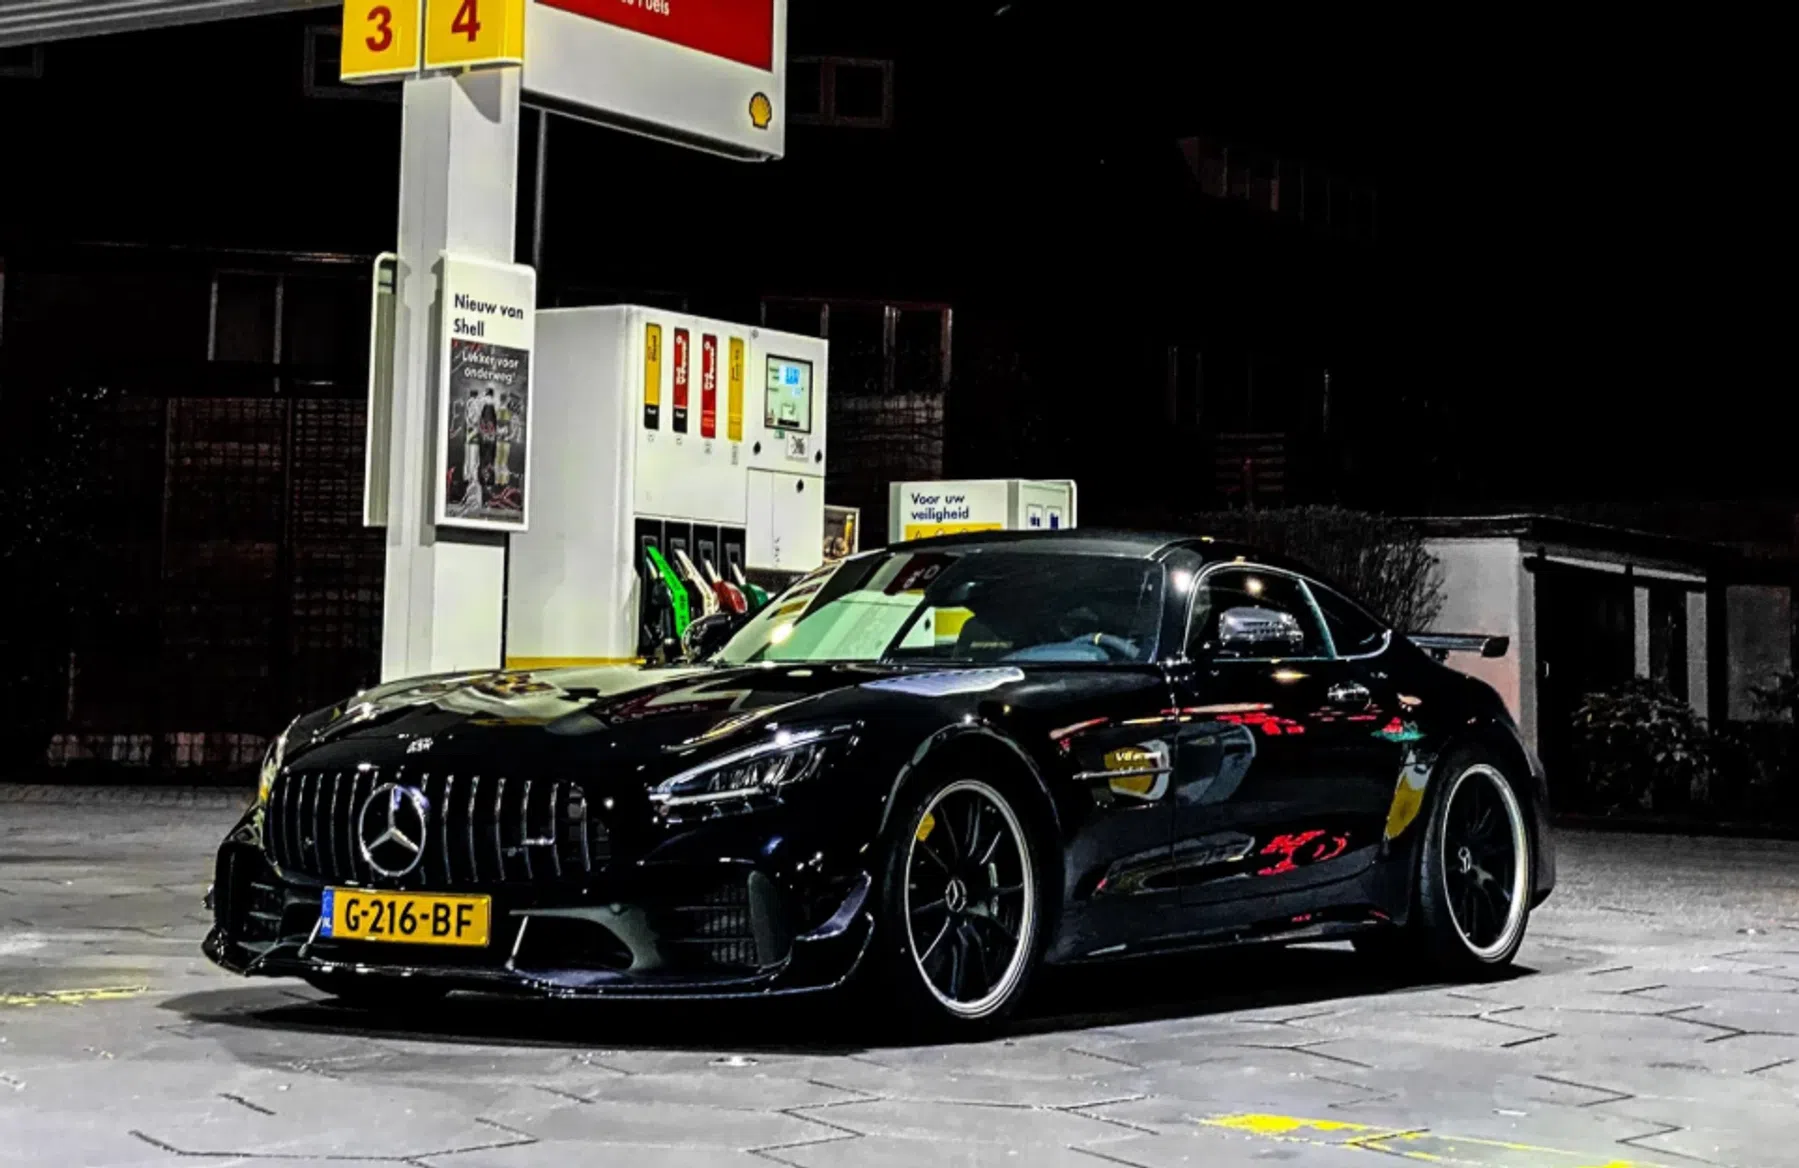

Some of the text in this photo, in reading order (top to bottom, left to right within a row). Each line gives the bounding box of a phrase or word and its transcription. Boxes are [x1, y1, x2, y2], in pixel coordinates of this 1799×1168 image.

[365, 6, 393, 52] 3
[450, 0, 482, 42] 4
[454, 293, 524, 320] Nieuw van
[453, 317, 484, 337] Shell
[911, 492, 965, 505] Voor uw
[911, 507, 969, 522] veiligheid
[345, 898, 474, 938] G-216-BF
